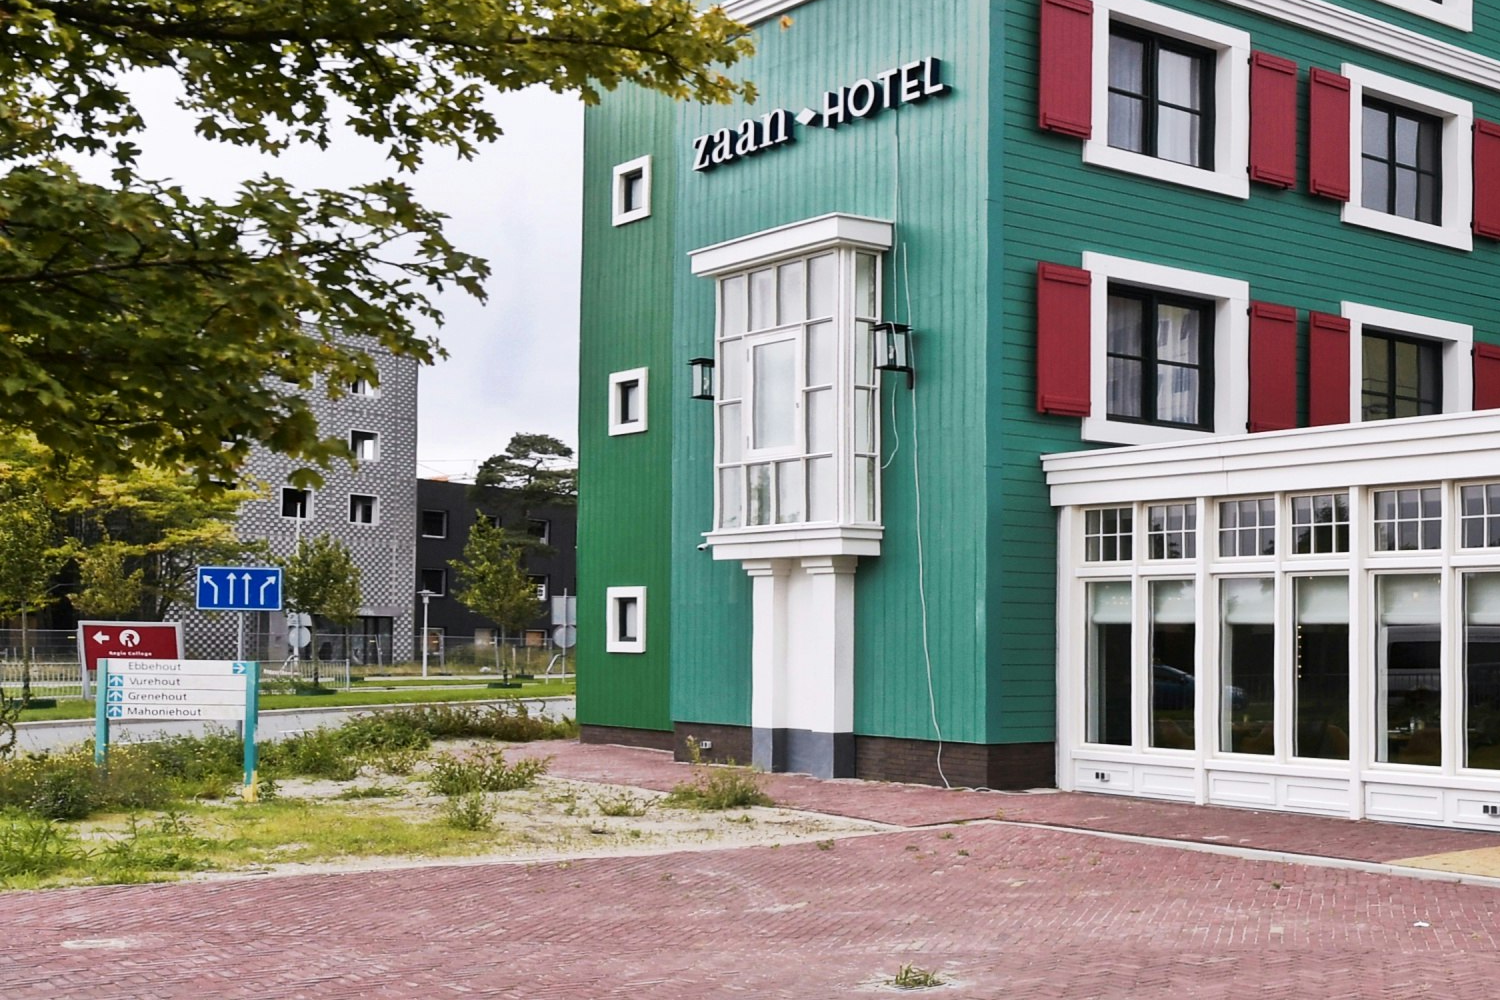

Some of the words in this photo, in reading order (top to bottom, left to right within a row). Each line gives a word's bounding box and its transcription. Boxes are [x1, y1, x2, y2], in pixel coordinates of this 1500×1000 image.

[691, 107, 793, 172] zaan
[822, 55, 945, 129] HOTEL
[128, 661, 182, 671] Ebbehout
[129, 677, 181, 686] Vurehout
[127, 692, 187, 701] Grenehout
[127, 707, 202, 717] Mahoniehout
